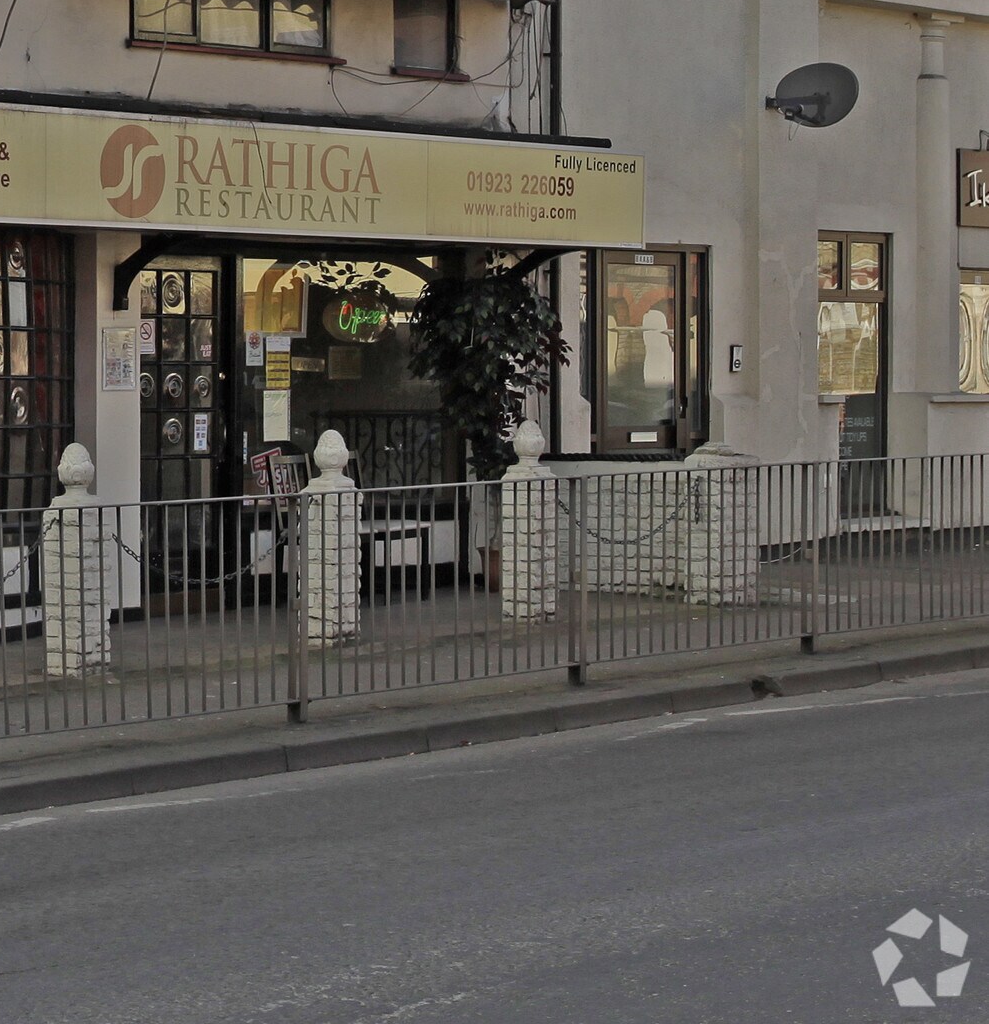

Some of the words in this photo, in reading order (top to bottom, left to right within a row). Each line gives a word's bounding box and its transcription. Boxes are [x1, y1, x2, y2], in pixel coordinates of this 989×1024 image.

[174, 134, 383, 194] RATHIGA
[554, 154, 582, 173] Fully
[586, 157, 636, 173] Licenced
[467, 171, 512, 193] 01923
[520, 174, 575, 196] 226059
[175, 188, 381, 224] RESTAURANT
[464, 202, 577, 222] www.rathiga.com
